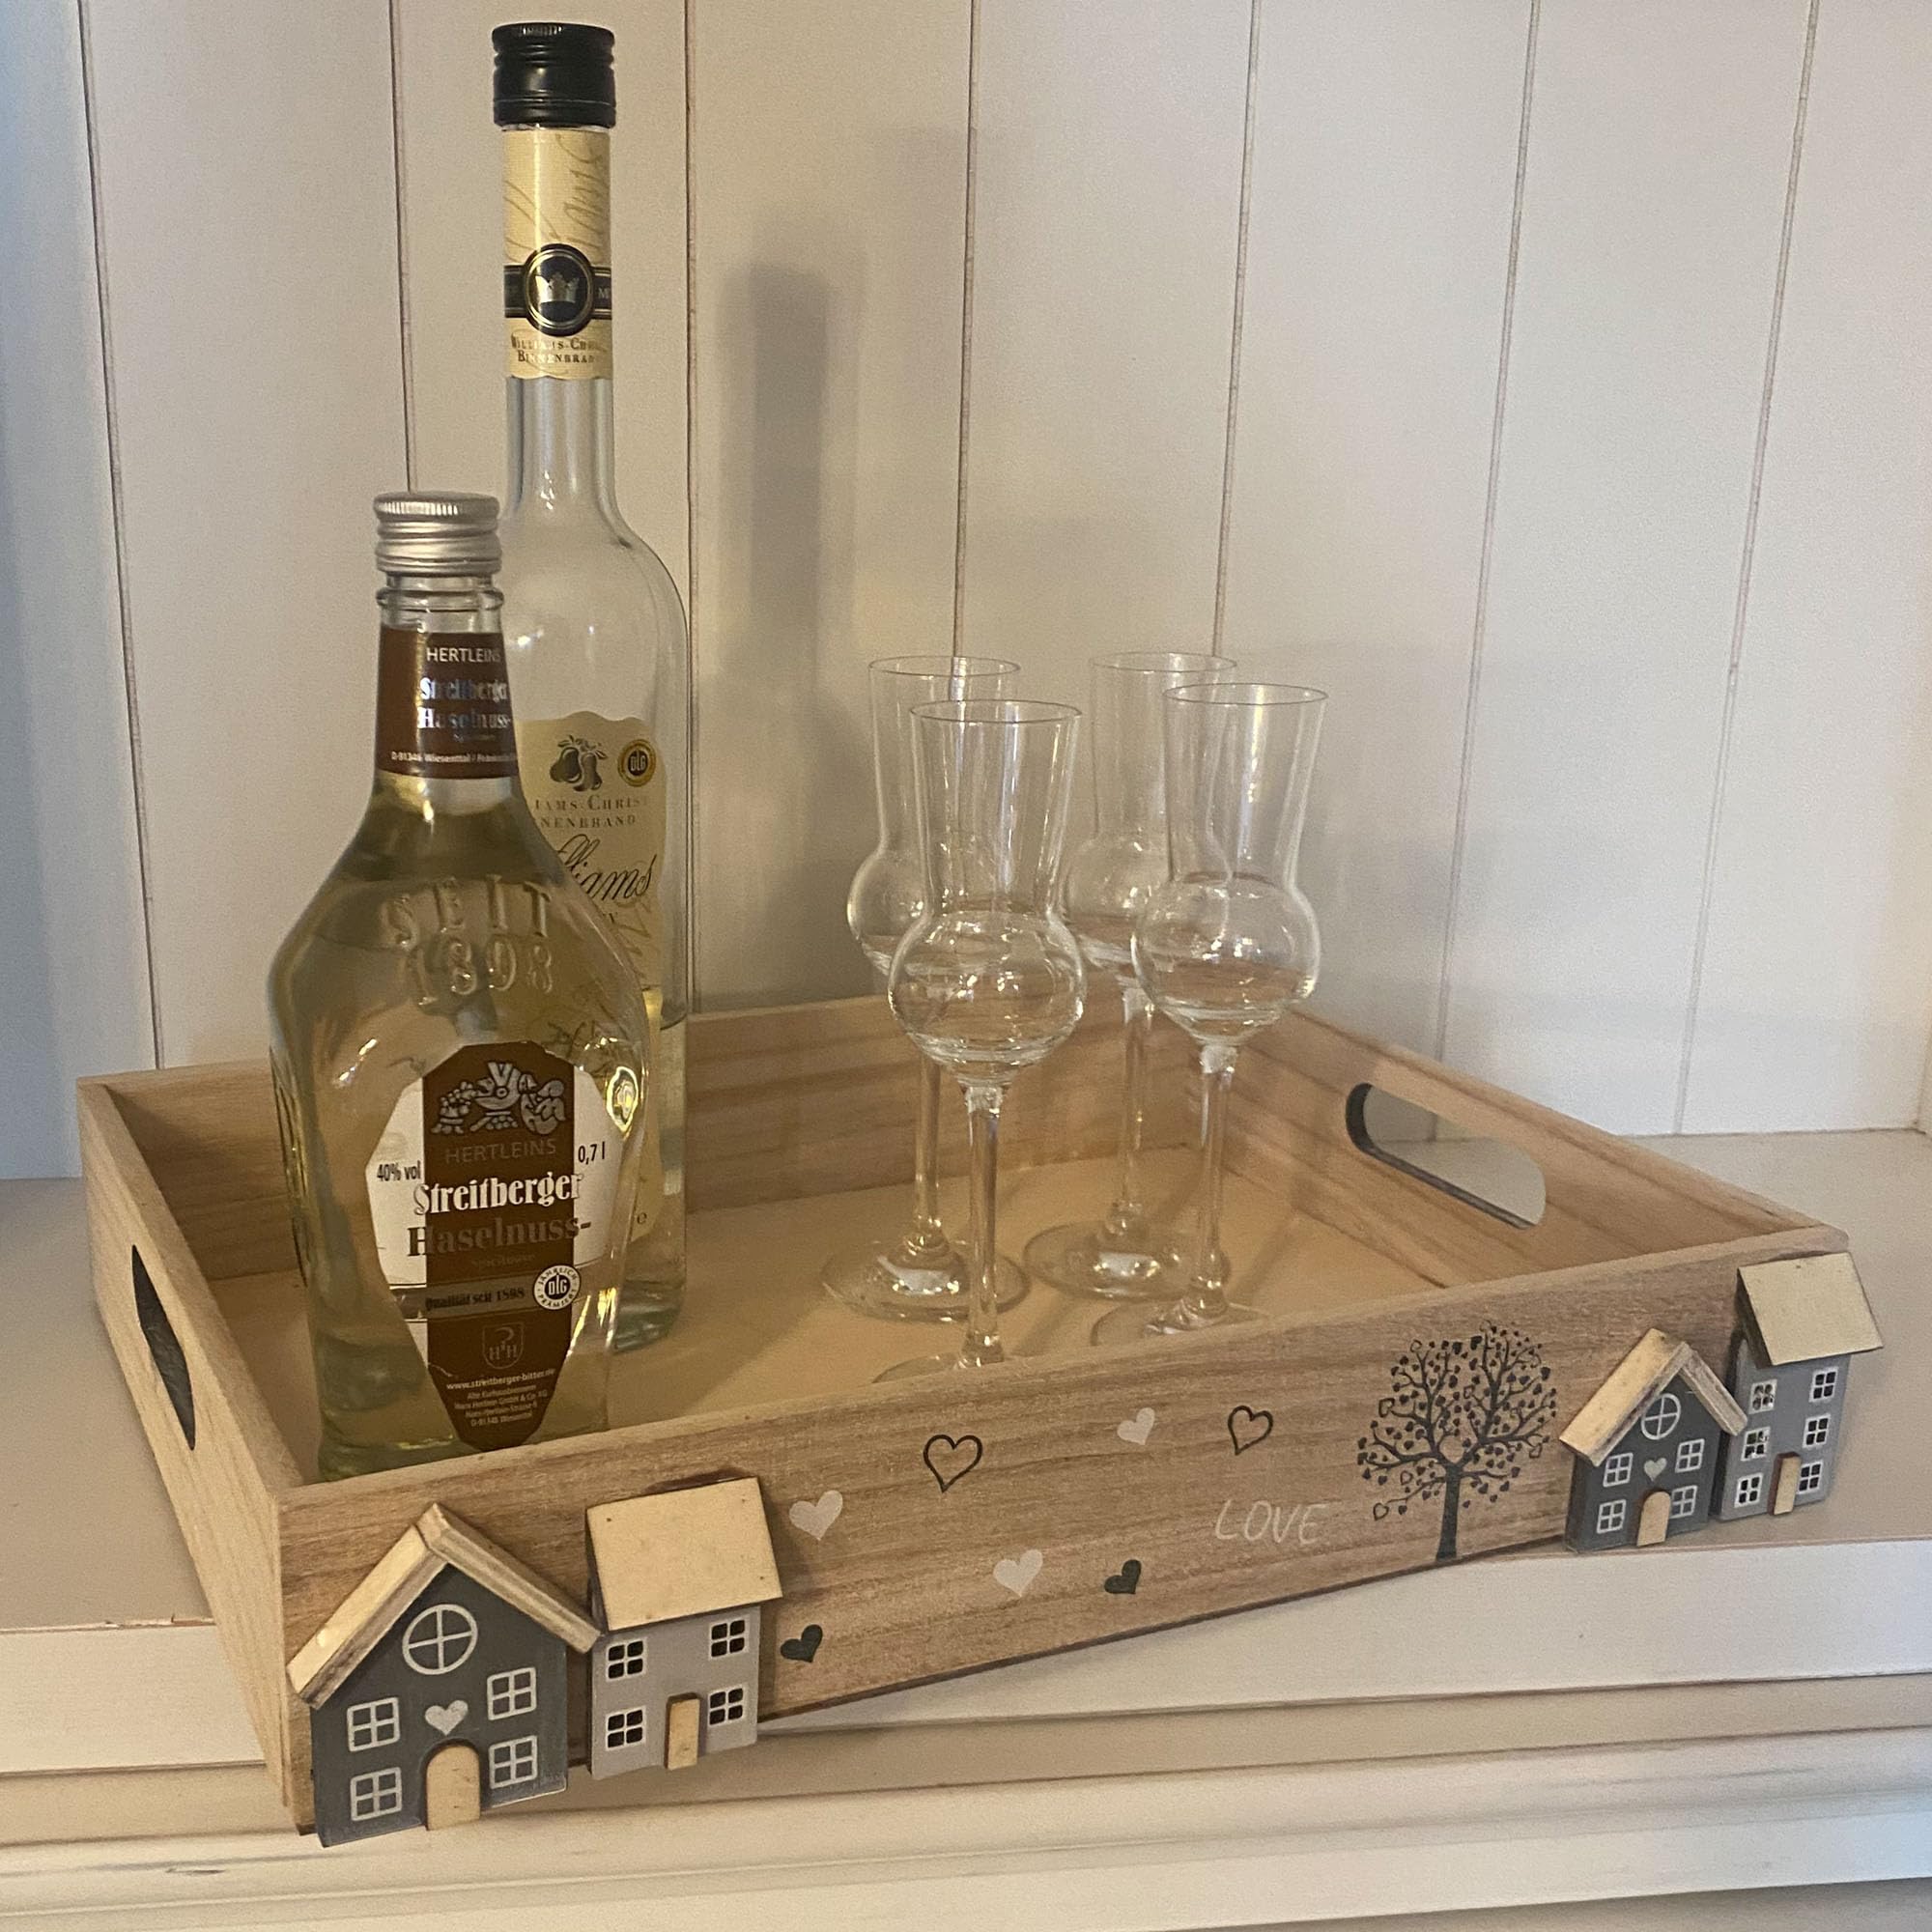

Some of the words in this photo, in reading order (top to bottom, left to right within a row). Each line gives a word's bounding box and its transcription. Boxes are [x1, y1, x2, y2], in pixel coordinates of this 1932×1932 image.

[445, 1139, 557, 1165] HERTLEINS
[578, 1144, 597, 1165] 0,7
[377, 1163, 401, 1182] 40%
[404, 1161, 421, 1180] vol
[548, 1274, 568, 1295] DLG
[1215, 1499, 1327, 1545] LOVE
